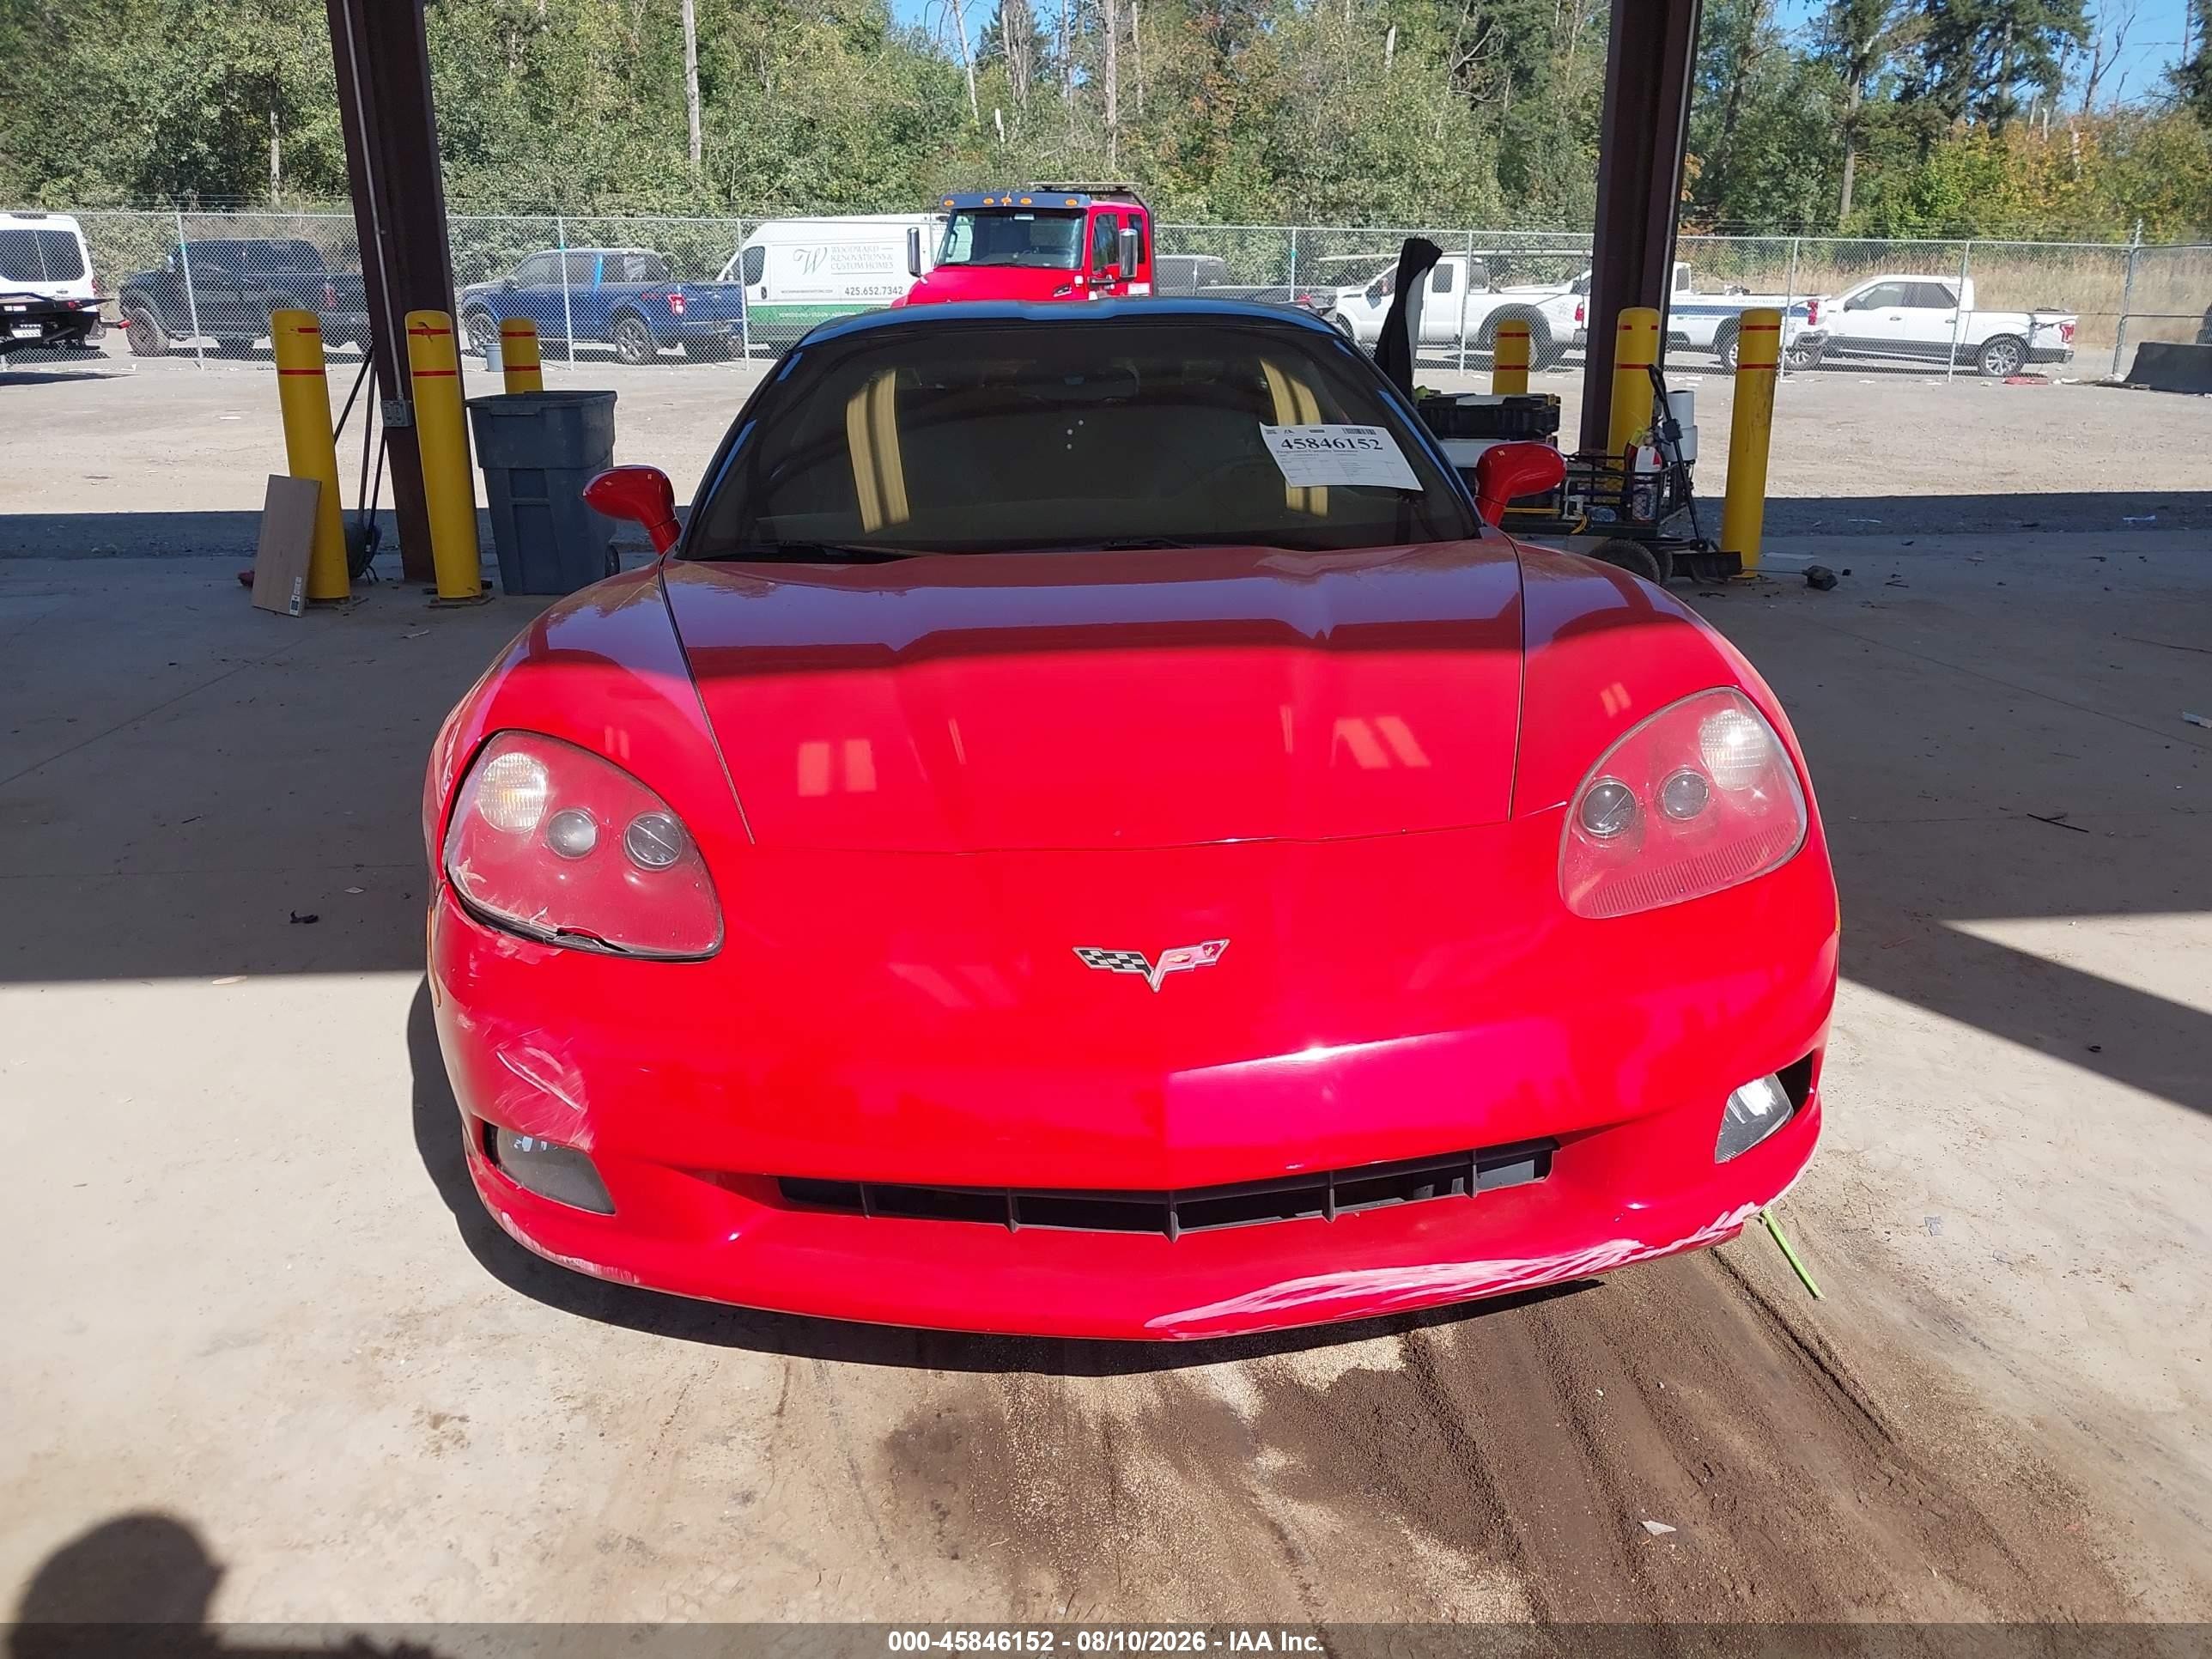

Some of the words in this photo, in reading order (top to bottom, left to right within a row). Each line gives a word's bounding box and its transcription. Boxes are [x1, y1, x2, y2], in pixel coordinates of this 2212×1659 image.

[793, 246, 828, 275] W
[844, 285, 903, 295] 425.652.7342
[1280, 437, 1383, 451] 45846152
